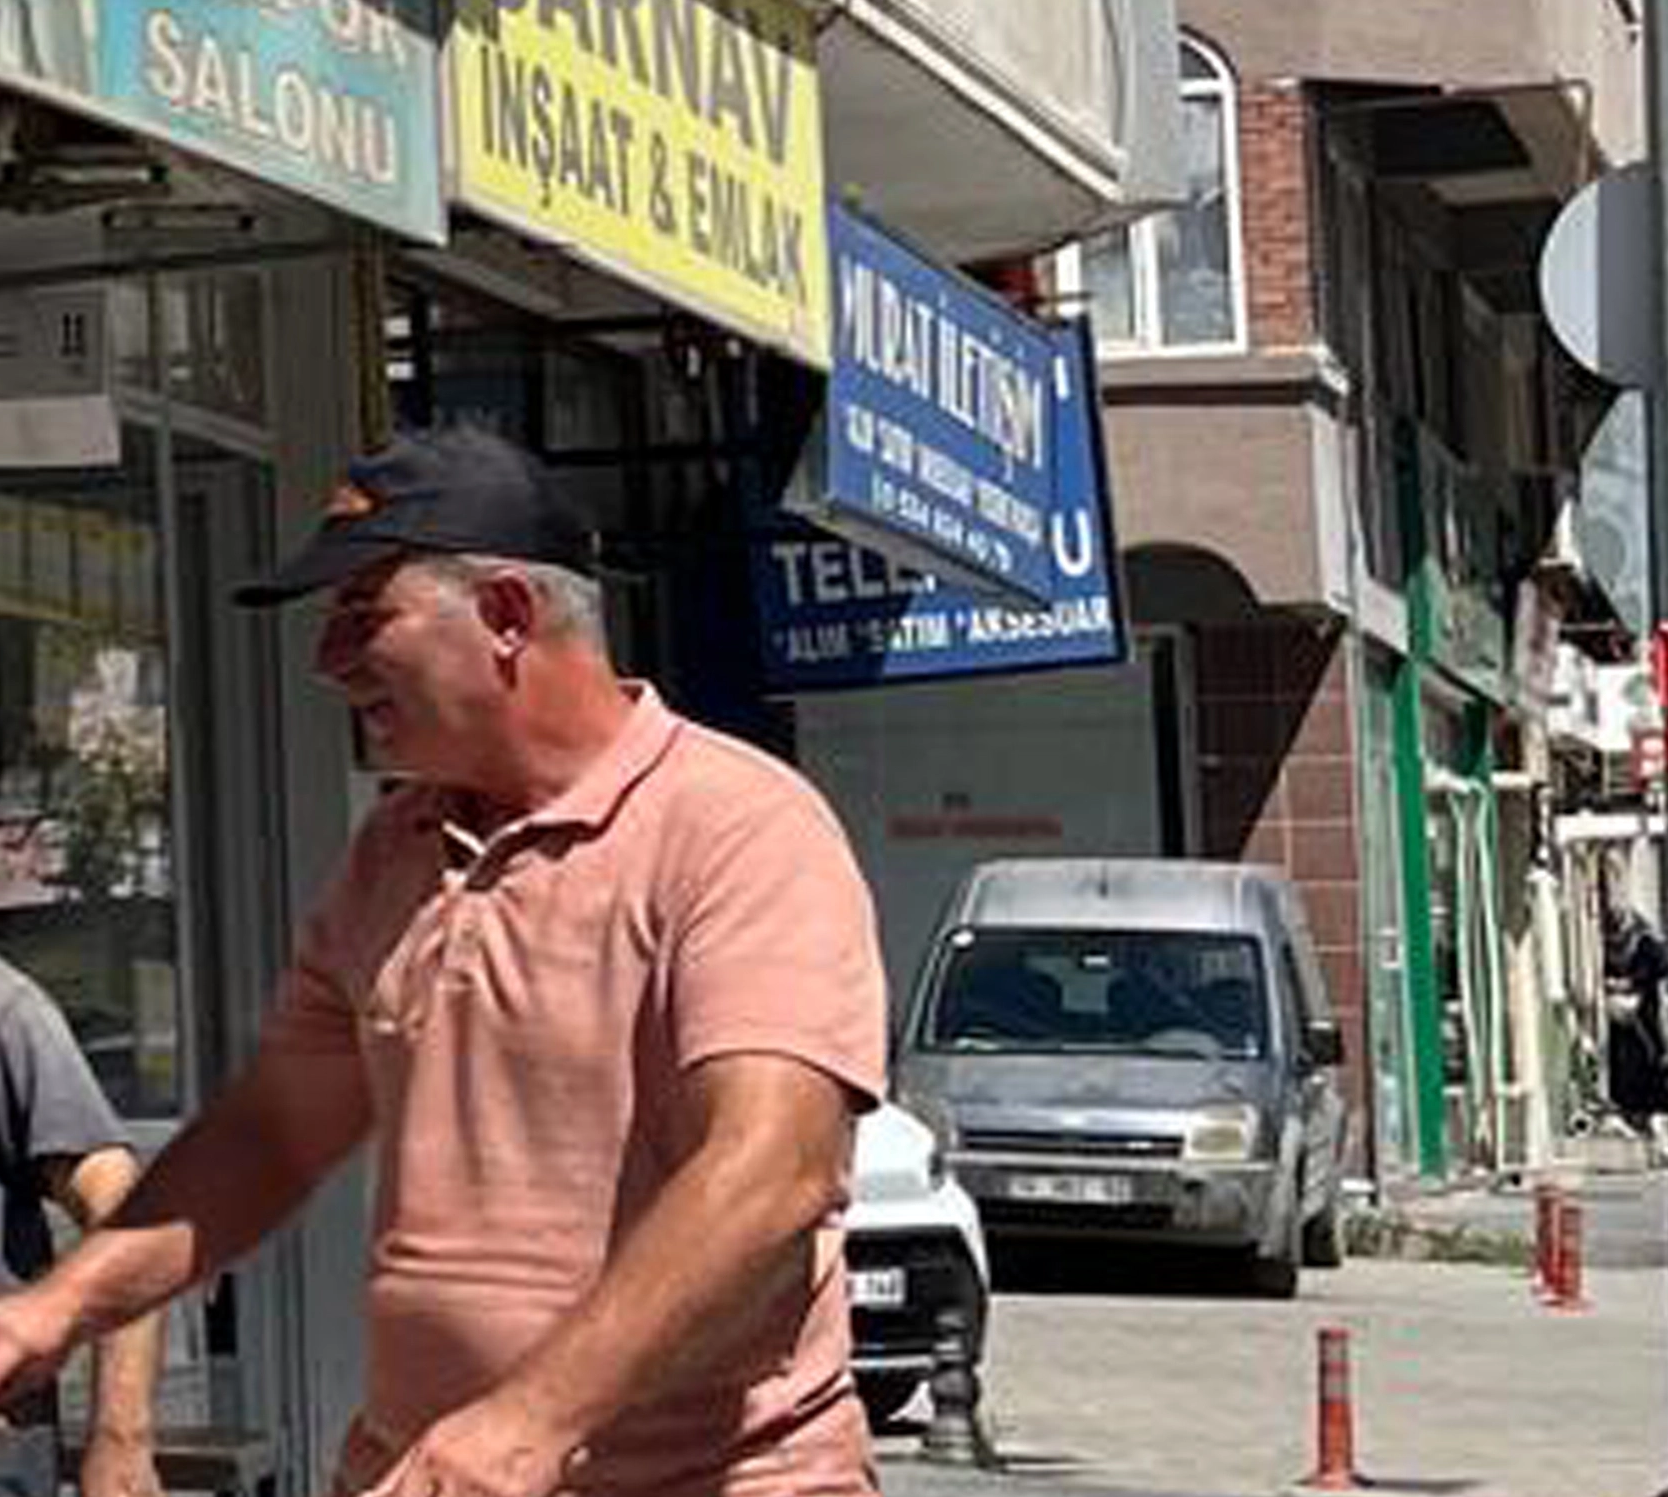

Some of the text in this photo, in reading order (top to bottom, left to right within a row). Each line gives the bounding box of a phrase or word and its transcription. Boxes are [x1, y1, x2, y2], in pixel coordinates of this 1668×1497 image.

[148, 12, 397, 182] SALONU
[648, 132, 677, 237] &
[688, 149, 807, 307] EMLAK
